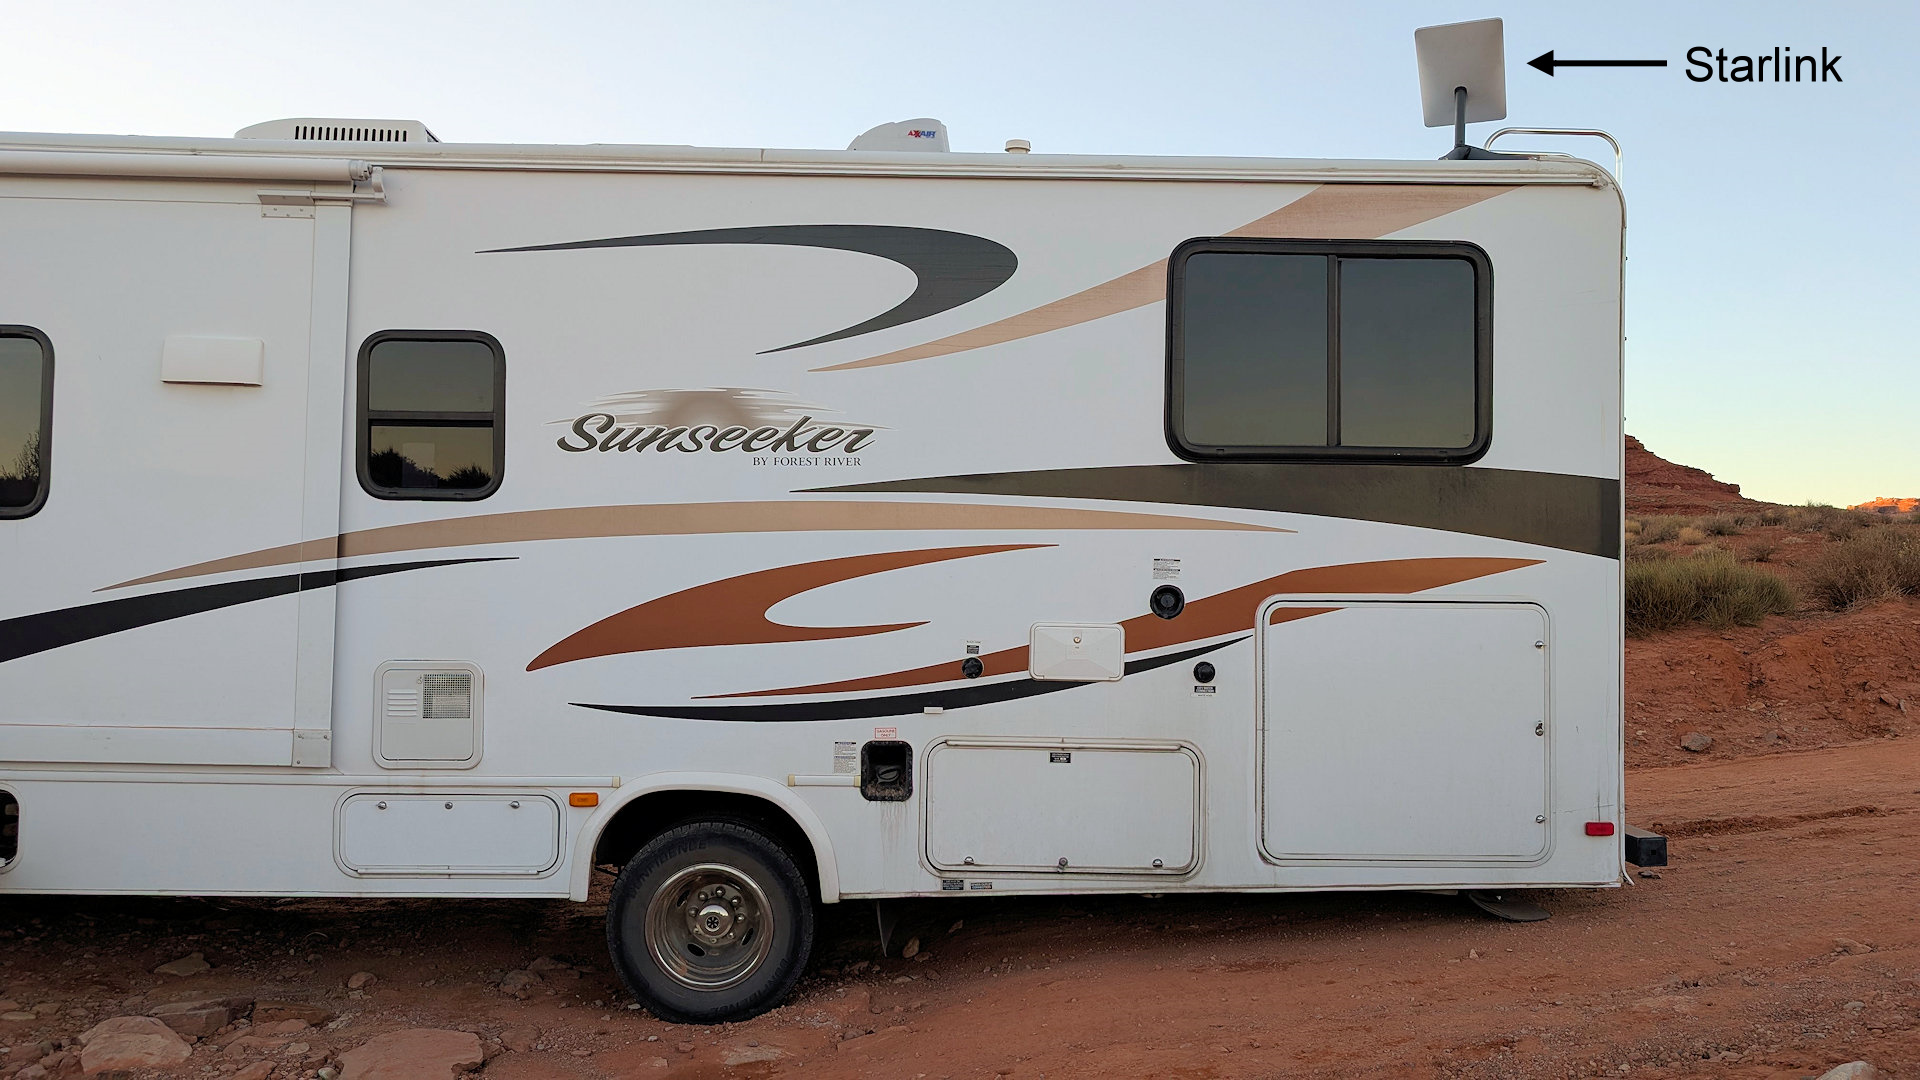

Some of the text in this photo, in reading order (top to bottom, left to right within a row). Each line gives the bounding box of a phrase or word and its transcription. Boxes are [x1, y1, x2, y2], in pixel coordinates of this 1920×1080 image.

[557, 413, 876, 453] Sunseeker
[753, 457, 861, 466] BY FOREST RIVER
